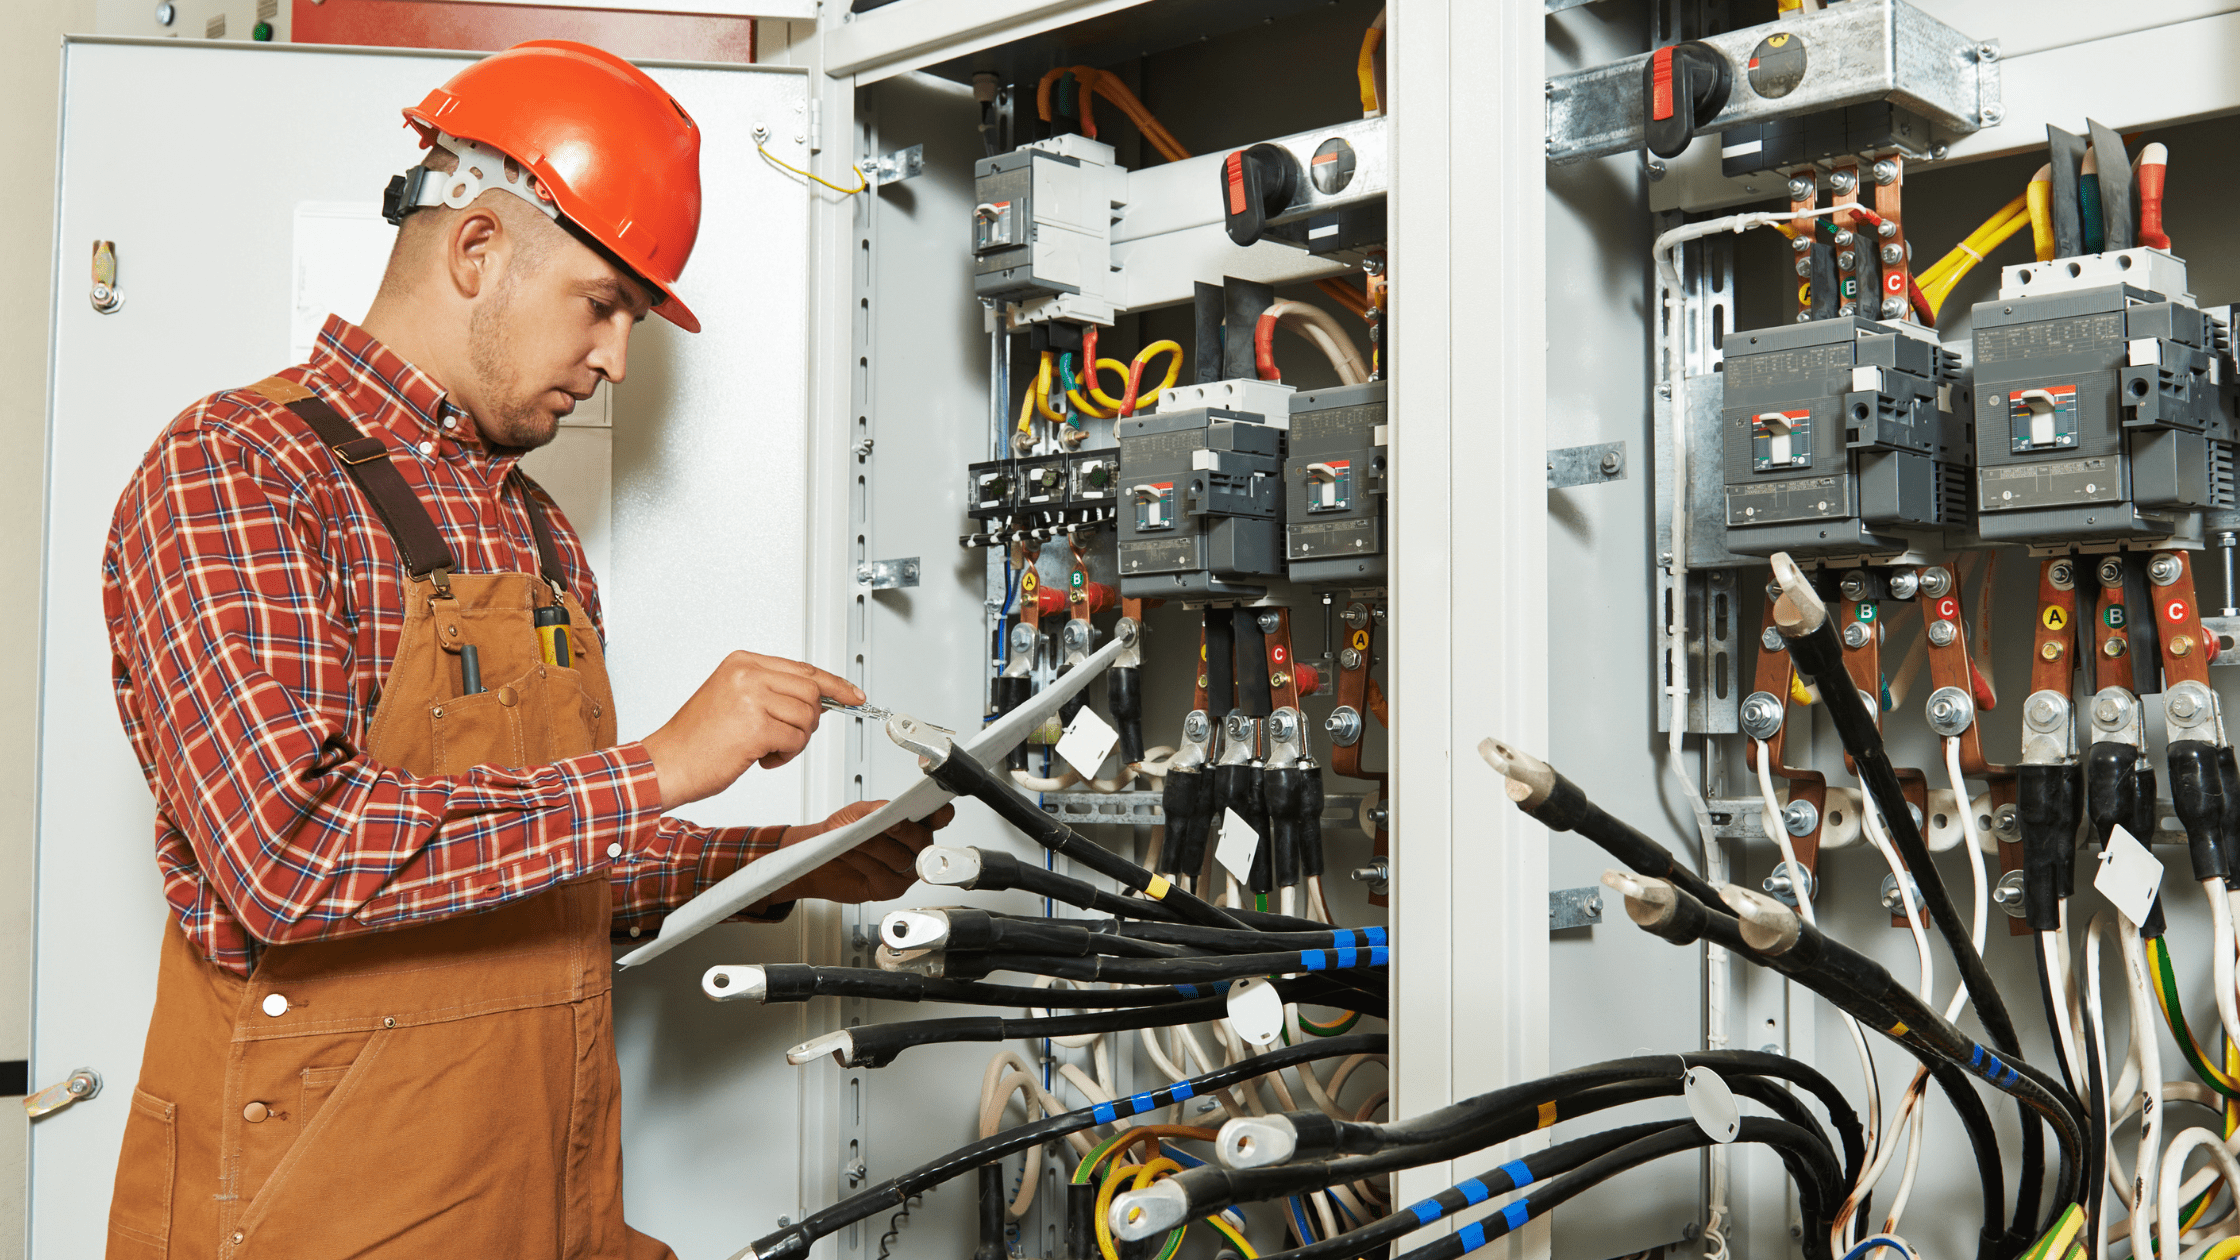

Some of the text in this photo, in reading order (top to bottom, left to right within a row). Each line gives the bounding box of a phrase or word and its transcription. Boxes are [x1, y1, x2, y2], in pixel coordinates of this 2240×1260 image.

[1846, 280, 1856, 295] B
[1888, 275, 1901, 290] C
[1026, 576, 1033, 586] A
[1073, 573, 1080, 584] B
[1861, 604, 1873, 618] B
[1941, 601, 1953, 615] C
[2169, 603, 2183, 618] C
[2049, 609, 2062, 624] A
[2110, 608, 2123, 624] B
[1356, 633, 1365, 646] A
[1274, 648, 1283, 660] C
